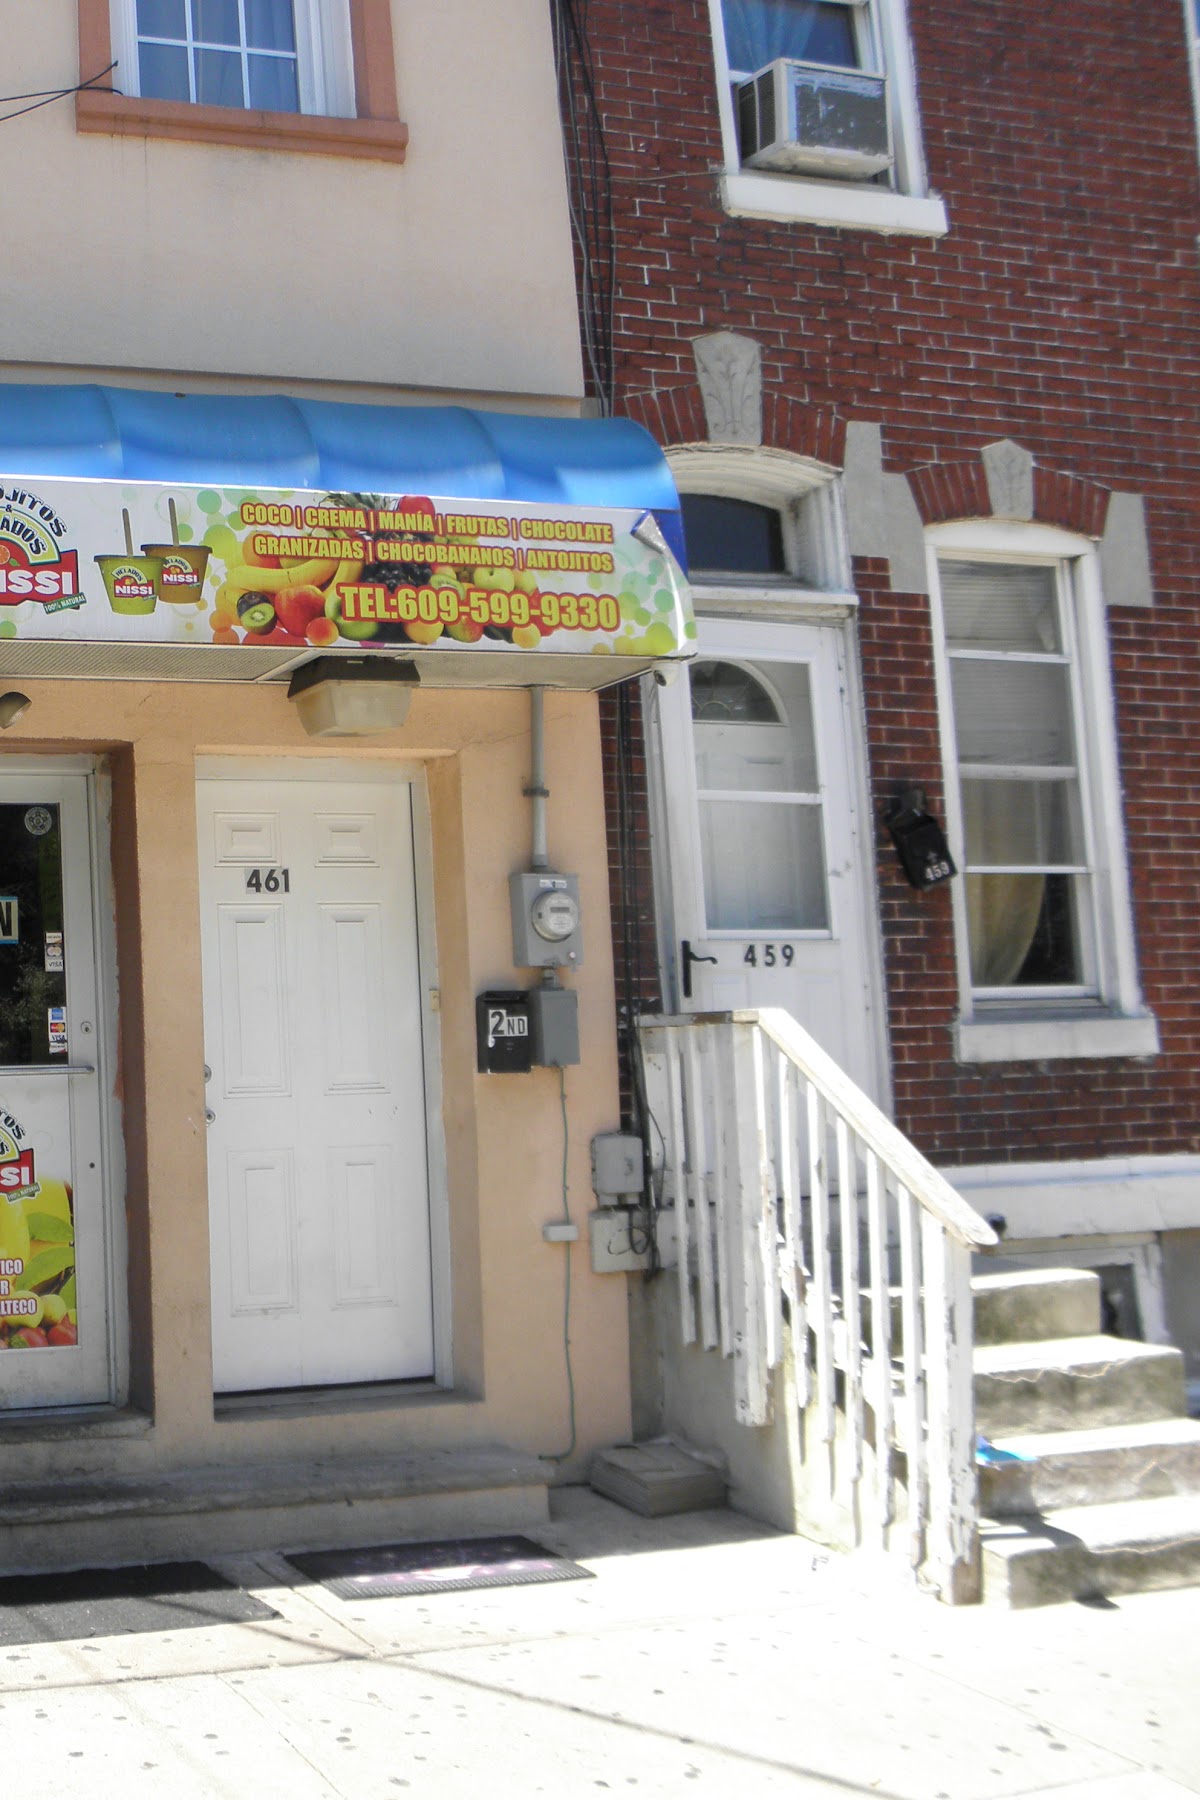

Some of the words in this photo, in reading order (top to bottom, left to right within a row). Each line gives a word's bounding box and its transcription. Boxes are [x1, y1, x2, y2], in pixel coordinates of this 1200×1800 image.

[5, 504, 13, 513] &
[243, 504, 292, 525] COCO
[305, 508, 367, 529] CREMA
[379, 510, 435, 532] MANÍA
[447, 515, 510, 537] FRUTAS
[520, 519, 613, 543] CHOCOLATE
[255, 535, 364, 560] GRANIZADAS
[377, 541, 514, 567] CHOCOBANANOS
[527, 550, 613, 573] ANTOJITOS
[163, 574, 197, 583] NISSI
[115, 585, 152, 595] NISSI
[44, 602, 61, 614] 100%
[61, 594, 86, 608] NATURAL
[339, 586, 619, 629] TEL:609-599-9330
[246, 869, 290, 893] 461
[925, 860, 950, 881] 459
[49, 960, 63, 968] VISA
[744, 944, 795, 968] 459
